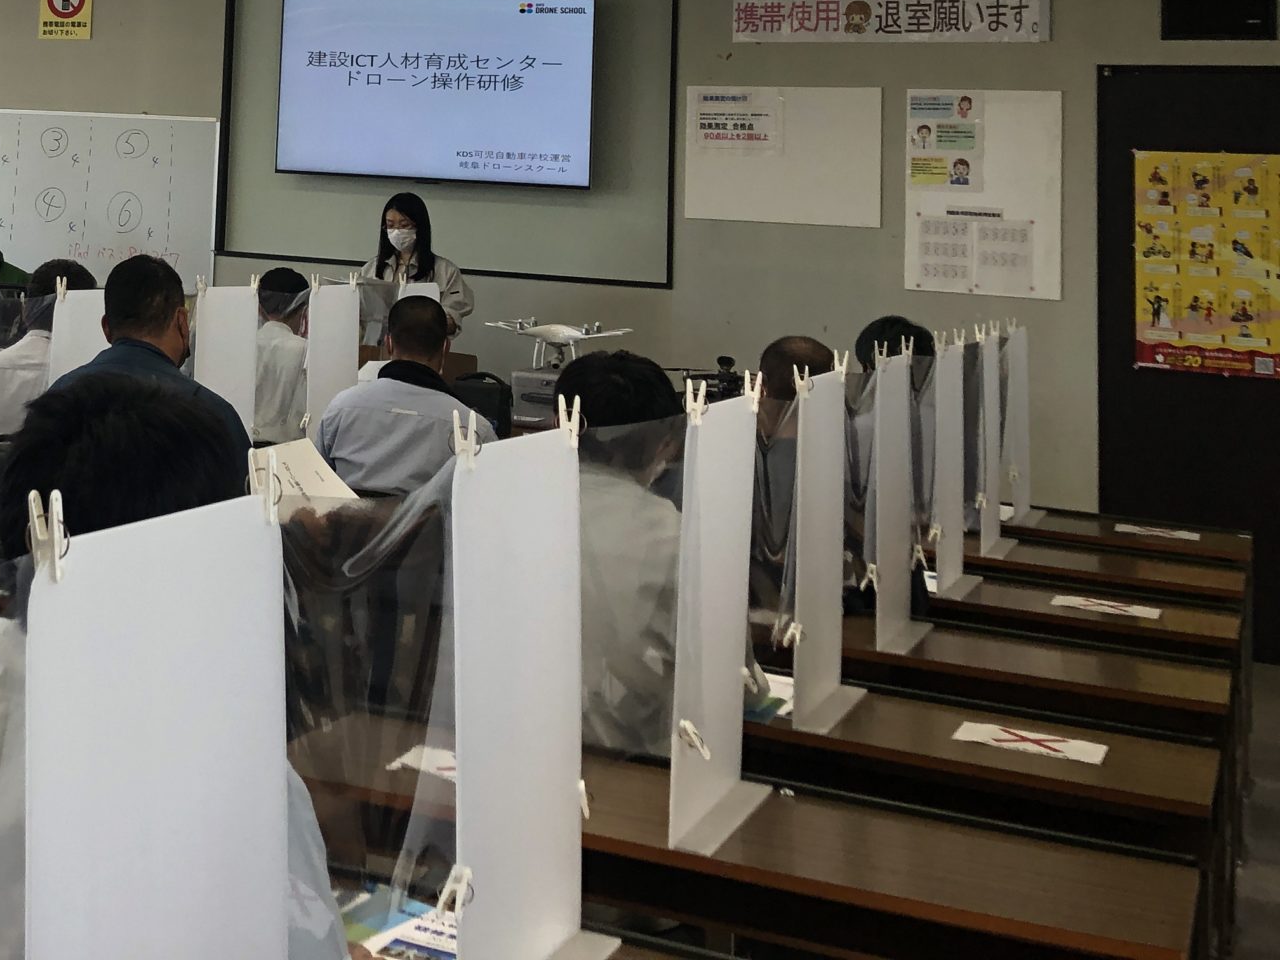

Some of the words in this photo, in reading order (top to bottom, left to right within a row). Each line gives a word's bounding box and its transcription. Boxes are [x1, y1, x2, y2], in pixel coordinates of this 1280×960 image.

[560, 7, 588, 15] SCHOOL
[735, 0, 840, 34] 携帯使用
[306, 50, 563, 72] 建設ICT人材育成センター
[346, 70, 525, 92] ドローン操作研修
[459, 161, 568, 173] 岐阜ドローンスクール
